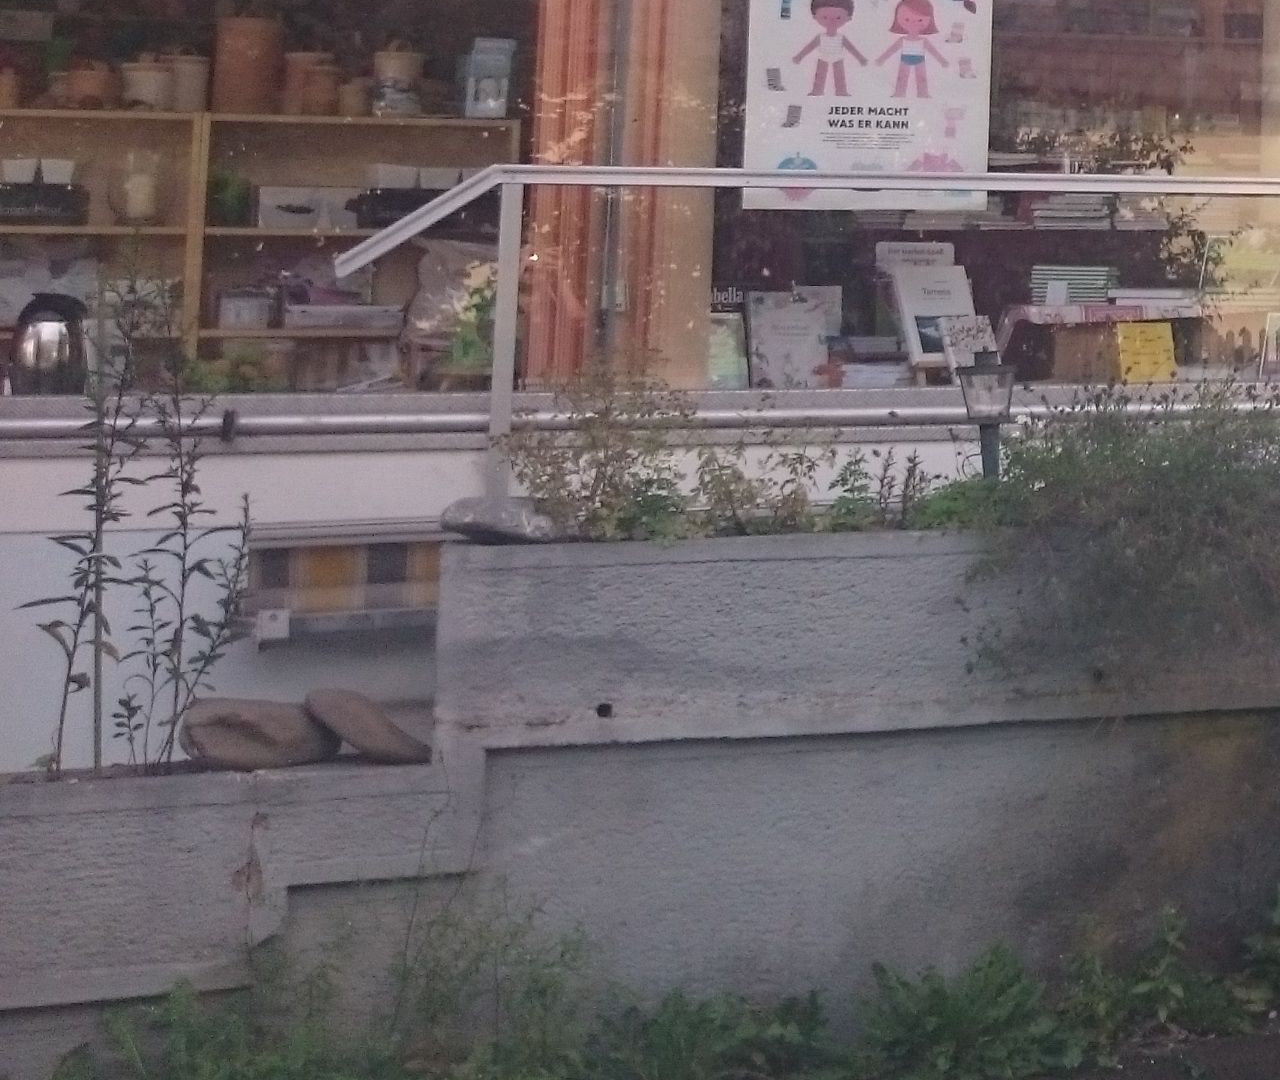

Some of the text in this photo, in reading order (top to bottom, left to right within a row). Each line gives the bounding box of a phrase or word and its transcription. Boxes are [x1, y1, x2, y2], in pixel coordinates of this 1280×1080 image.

[828, 106, 910, 117] JEDER MACHT
[828, 119, 909, 129] WAS ER KANN
